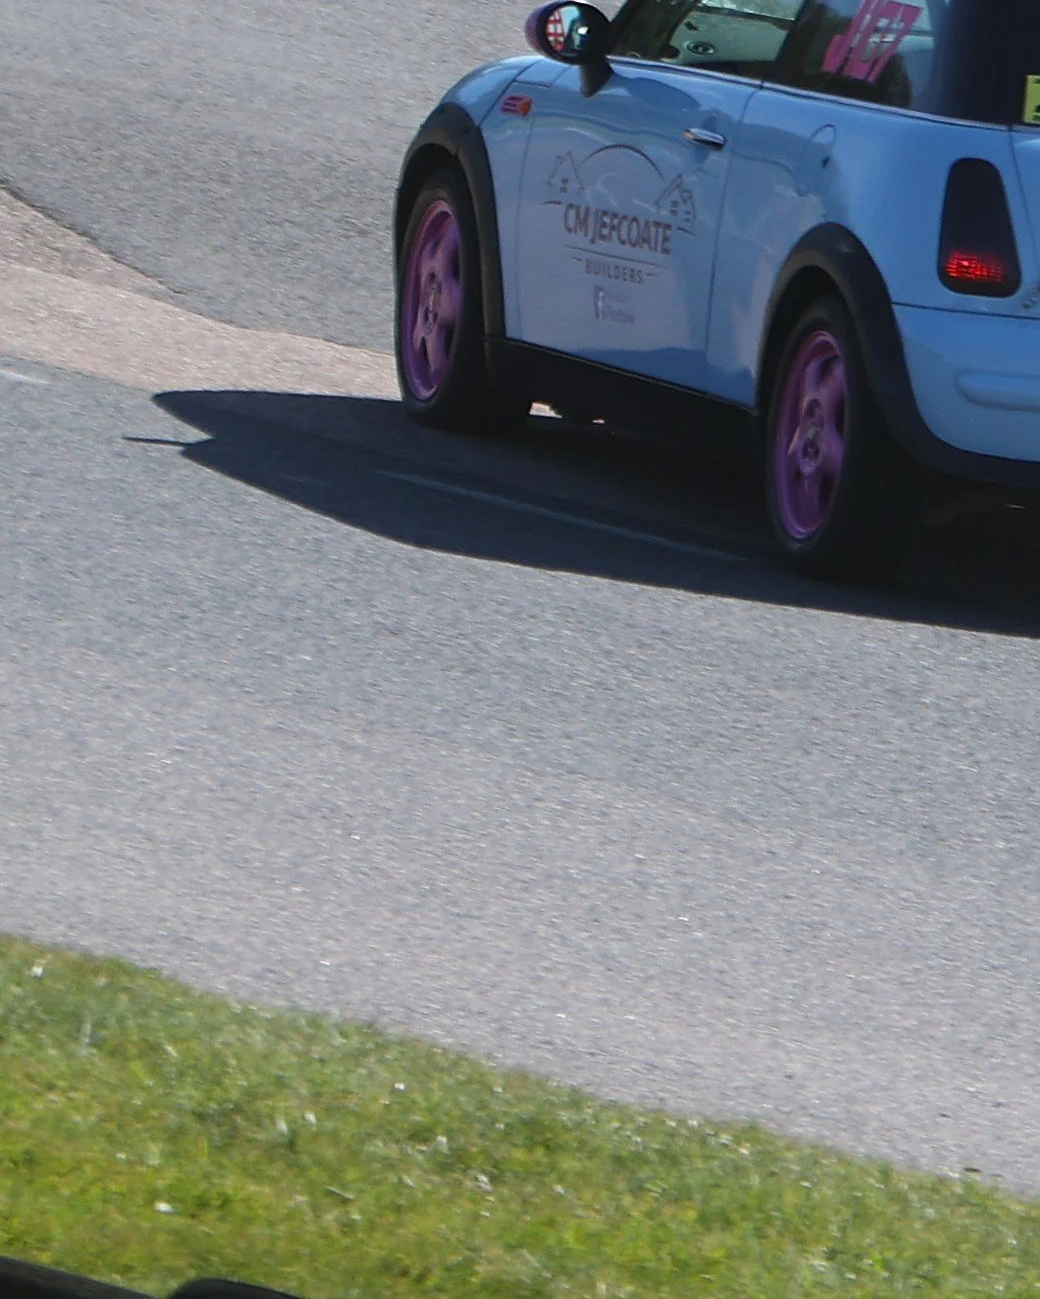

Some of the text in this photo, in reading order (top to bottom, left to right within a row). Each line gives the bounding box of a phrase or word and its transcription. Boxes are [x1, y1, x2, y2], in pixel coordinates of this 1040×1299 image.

[564, 203, 673, 254] CM JEFCOATE
[585, 259, 644, 285] BUILDERS
